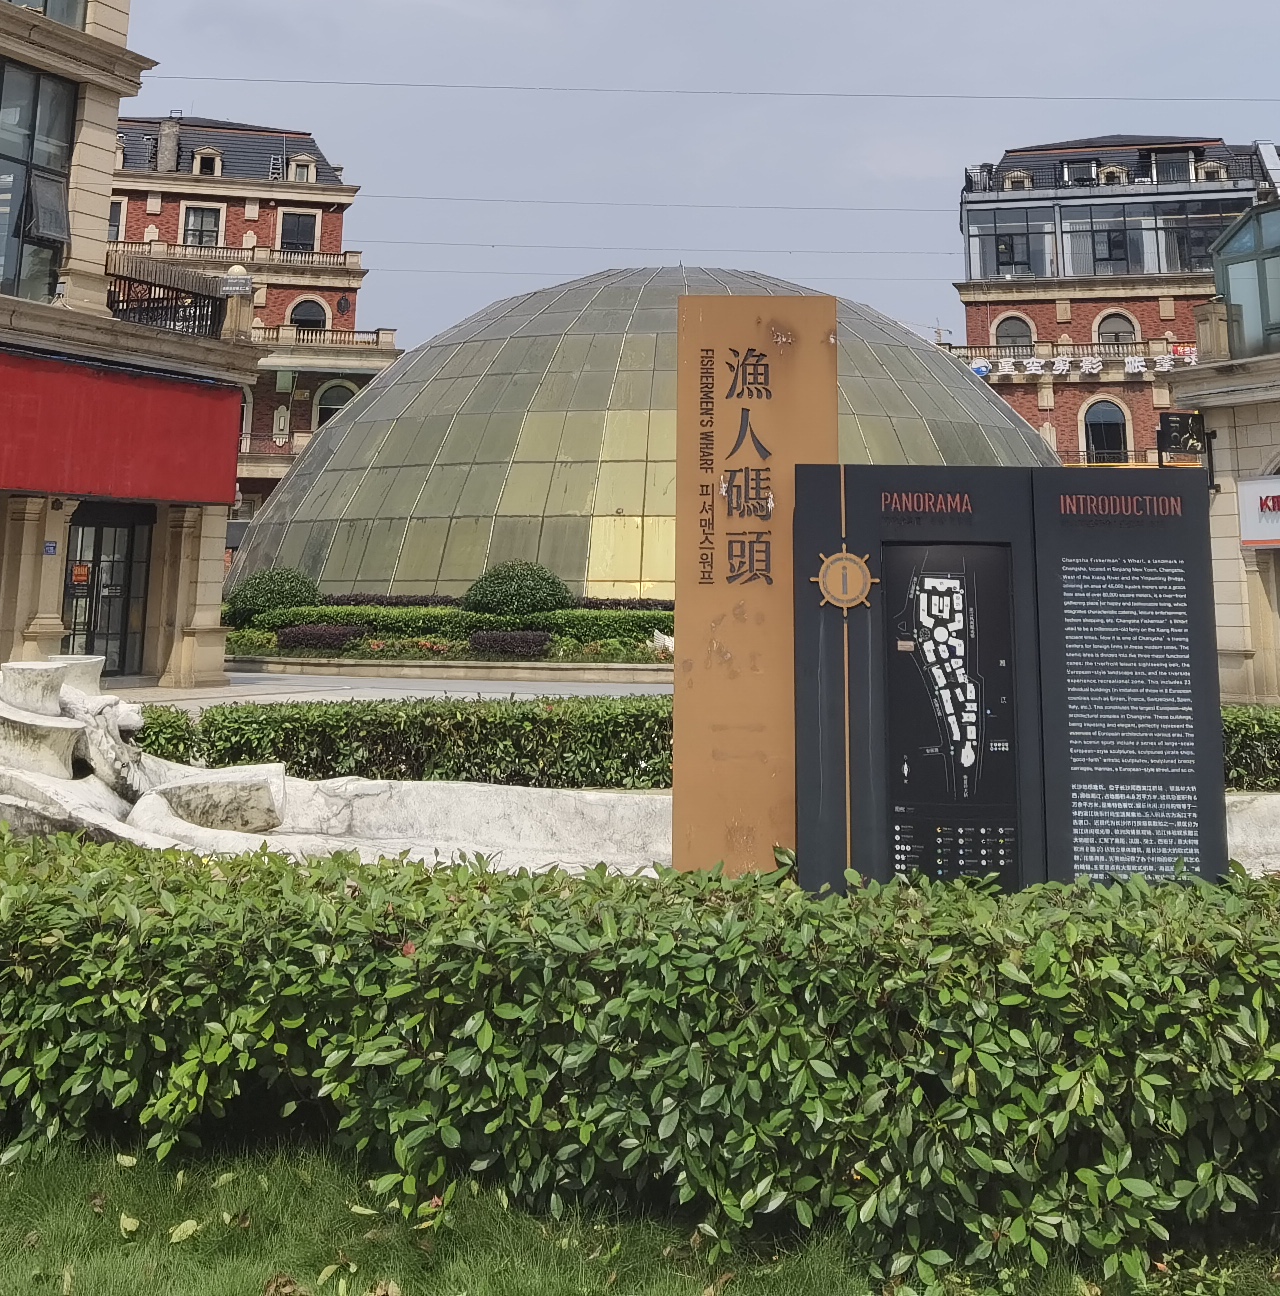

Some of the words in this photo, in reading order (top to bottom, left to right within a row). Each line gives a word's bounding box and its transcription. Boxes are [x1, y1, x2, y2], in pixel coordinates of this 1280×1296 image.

[699, 431, 714, 475] WHARF
[724, 347, 774, 586] 漁人碼頭
[881, 492, 972, 514] PANORAMA
[1060, 494, 1182, 517] INTRODUCTION
